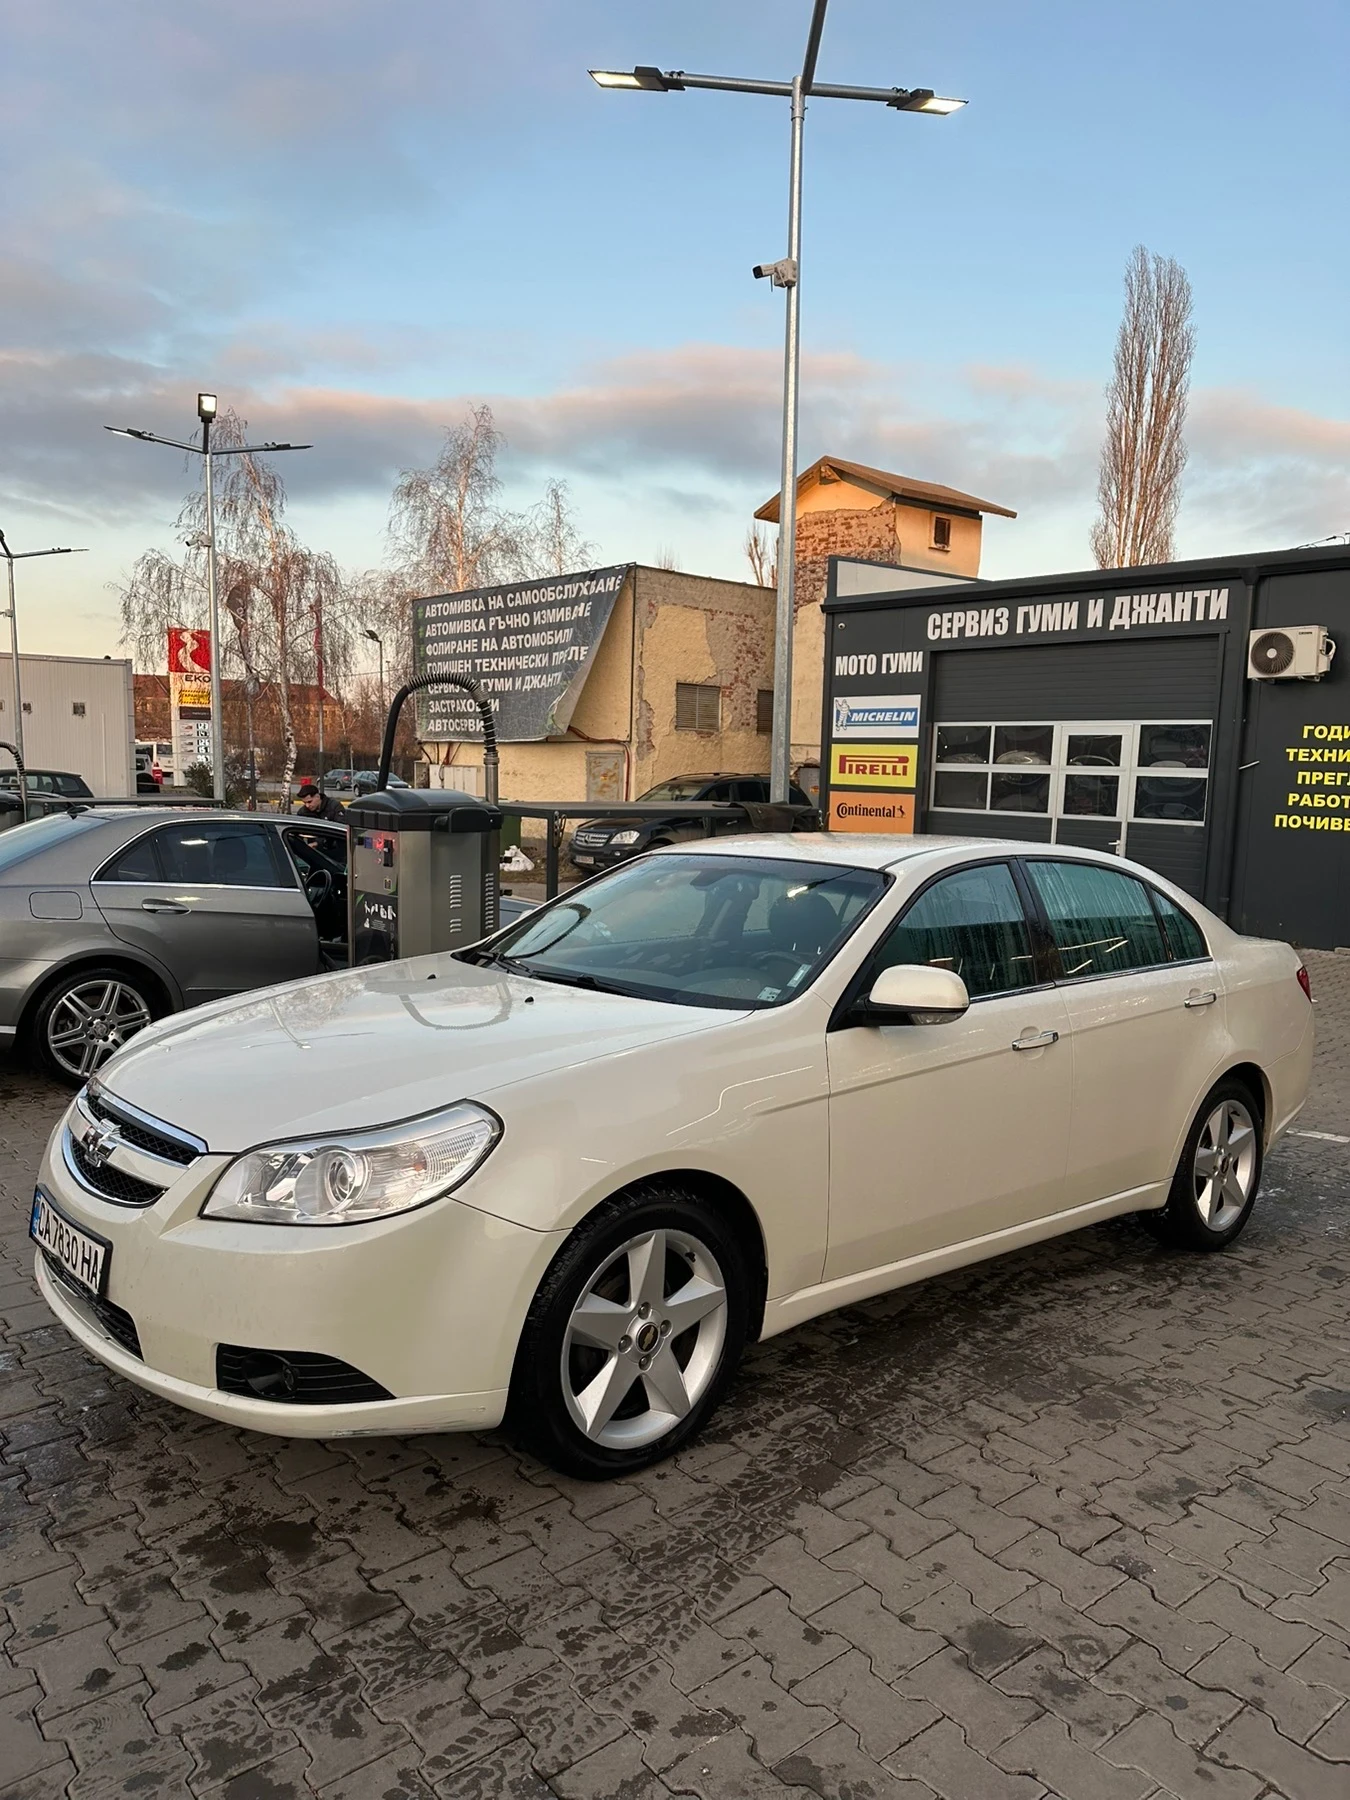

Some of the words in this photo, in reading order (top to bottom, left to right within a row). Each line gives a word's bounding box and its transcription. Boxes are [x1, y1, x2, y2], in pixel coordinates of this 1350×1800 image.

[425, 597, 486, 618] АВТОМИВКА
[488, 596, 504, 610] НА
[927, 607, 1009, 641] СЕРВИЗ
[1016, 601, 1079, 634] ГУМИ
[1087, 598, 1104, 629] И
[1109, 588, 1230, 631] ДЖАНТИ
[425, 618, 486, 637] АВТОМИВКА
[489, 612, 530, 631] РЪЧНО
[426, 638, 478, 657] ФОЛИРАНЕ
[481, 637, 498, 652] НА
[474, 653, 549, 672] ТЕХНИЧЕСКИ
[835, 654, 877, 676] МОТО
[881, 651, 923, 675] ГУМИ
[184, 674, 211, 683] EKO
[481, 677, 513, 692] ГУМИ
[515, 678, 522, 691] И
[429, 699, 500, 713] ЗАСТРАХОИ
[851, 711, 916, 722] MICHELIN
[1286, 748, 1350, 763] ТЕХНИ
[838, 754, 910, 776] PIRELLI
[1297, 771, 1350, 786] ПРЕГ
[1287, 793, 1350, 809] РАБОТ
[836, 802, 896, 819] Continental
[52, 1214, 79, 1271] 7830
[81, 1240, 99, 1290] HA
